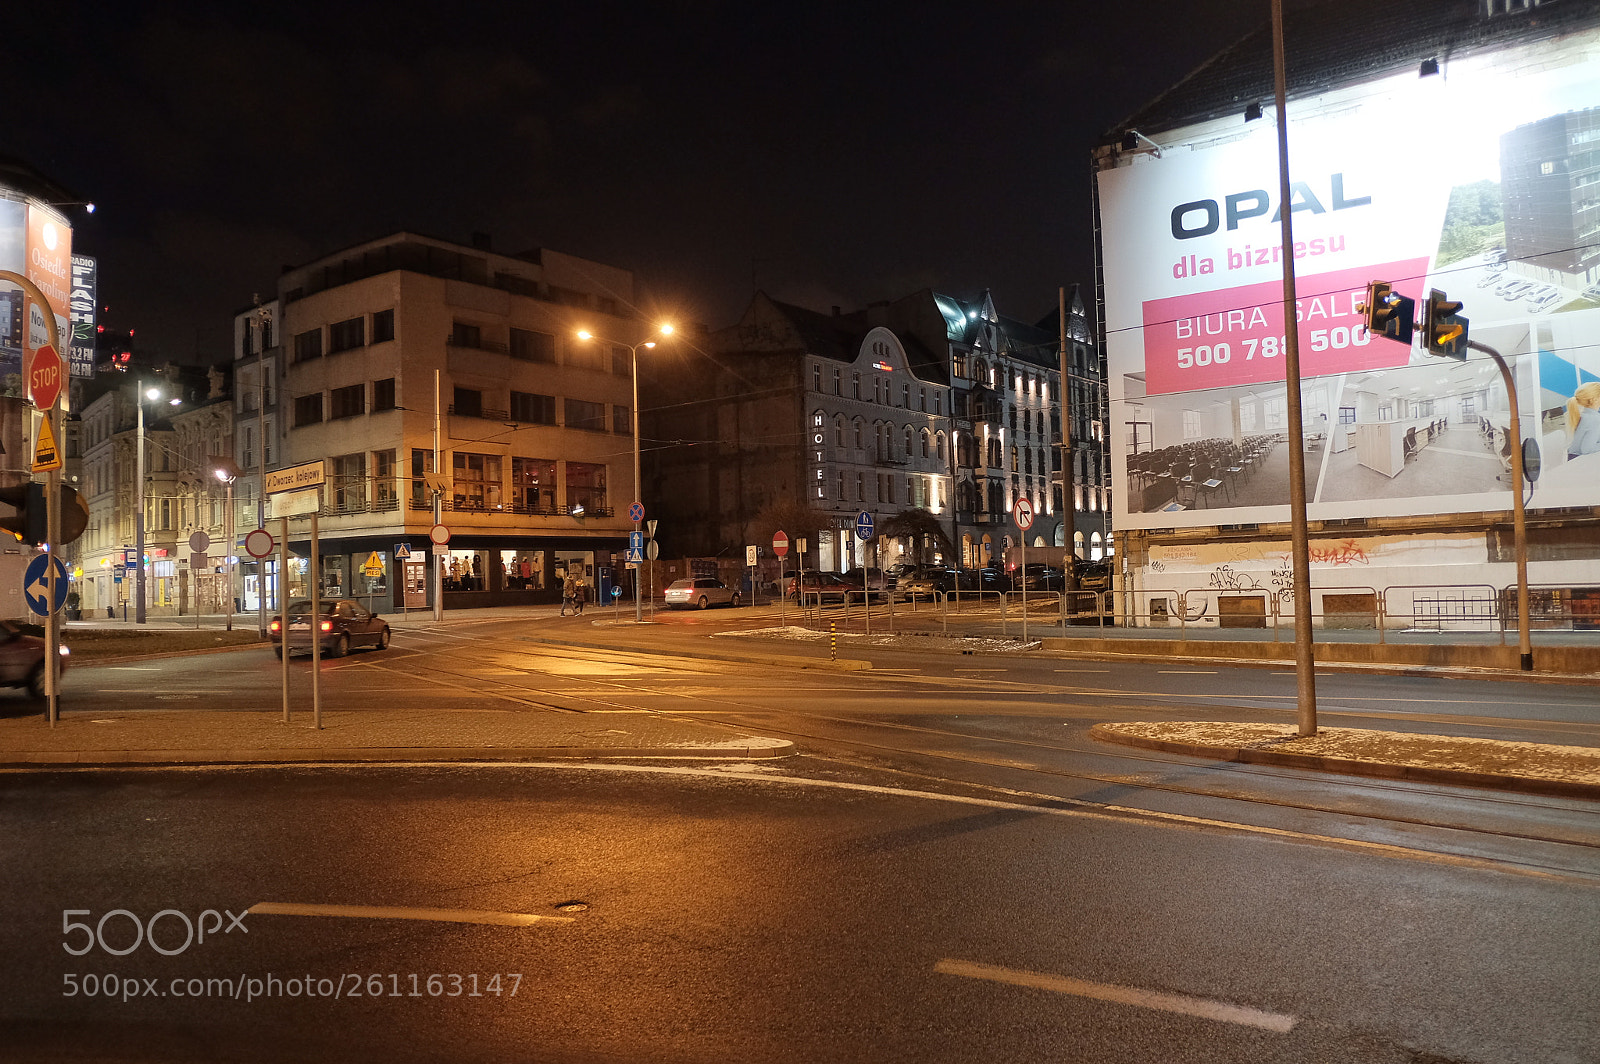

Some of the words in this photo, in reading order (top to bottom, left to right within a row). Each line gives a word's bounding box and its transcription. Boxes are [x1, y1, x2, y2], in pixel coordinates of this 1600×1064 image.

[1171, 173, 1371, 240] OPAL
[32, 247, 66, 279] Osiedle
[1172, 255, 1214, 279] dla
[29, 269, 69, 308] Karoliny
[1176, 307, 1268, 339] BIURA
[83, 348, 94, 361] FM
[1177, 343, 1231, 369] 500
[1310, 324, 1371, 352] 500
[33, 366, 57, 389] STOP
[81, 363, 92, 376] FM
[814, 415, 824, 498] HOTEL
[273, 475, 294, 487] Dworzec
[296, 468, 320, 483] kolejowy
